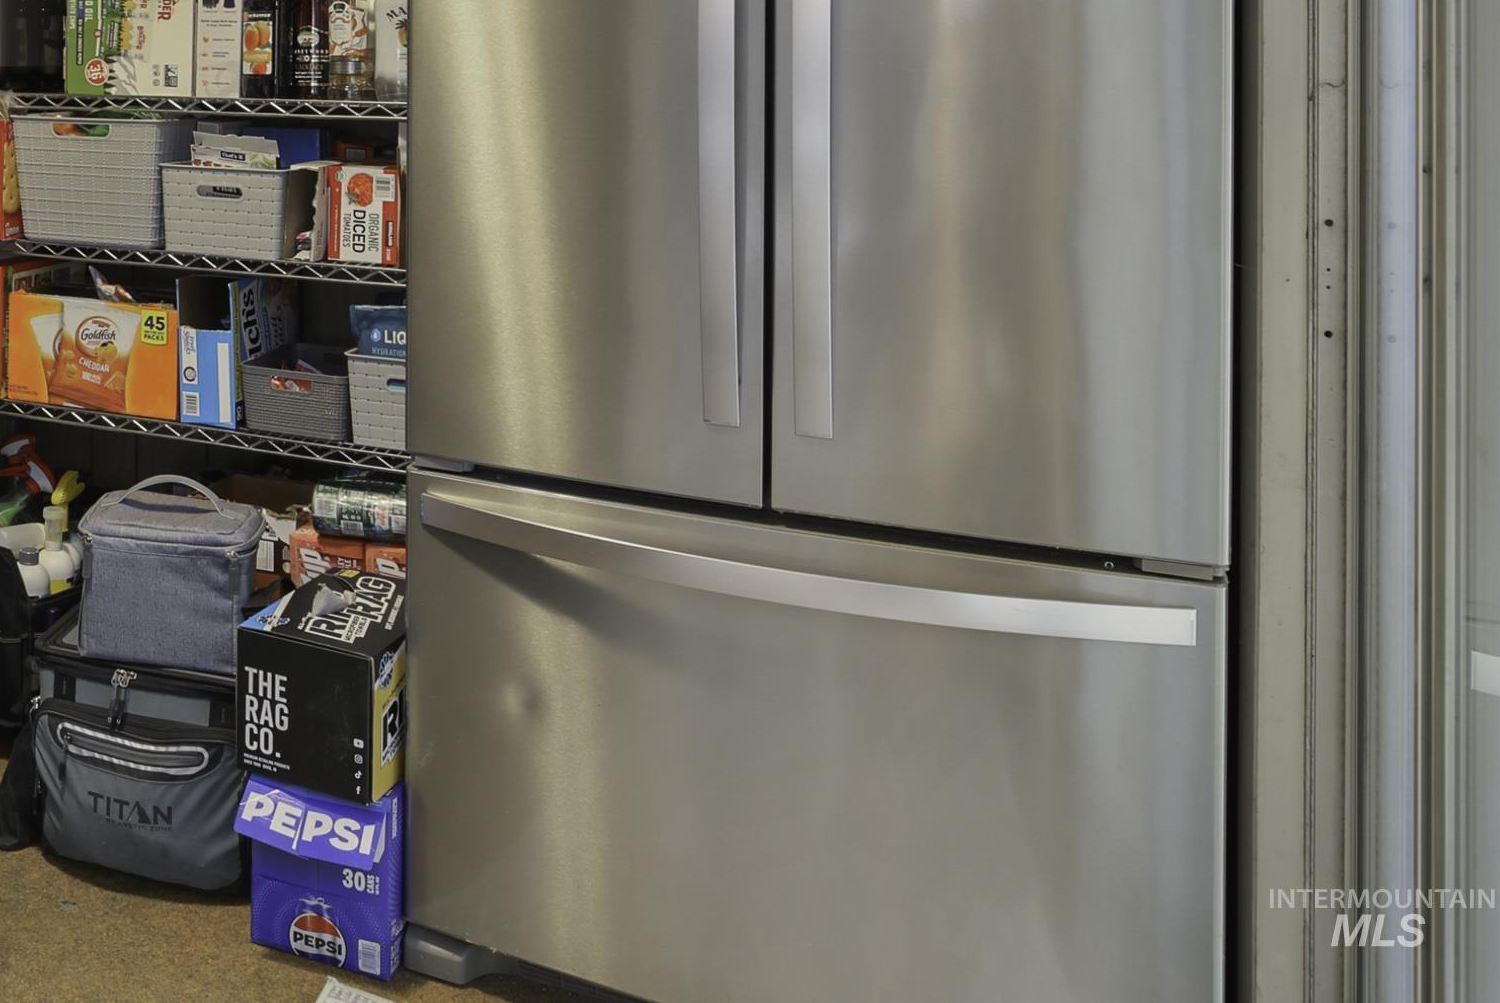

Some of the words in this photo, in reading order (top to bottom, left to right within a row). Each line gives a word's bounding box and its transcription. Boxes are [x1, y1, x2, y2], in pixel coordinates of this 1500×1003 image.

[84, 7, 93, 22] OIL
[343, 213, 351, 248] TOMATOES
[352, 209, 366, 253] DICED
[368, 213, 380, 252] ORGANIC
[81, 328, 116, 341] Goldfish
[144, 315, 165, 331] 45
[384, 331, 407, 345] LIQ
[78, 357, 110, 373] CHEDDAR
[351, 575, 396, 624] RAG
[244, 666, 288, 703] THE
[245, 694, 289, 731] RAG
[245, 723, 281, 758] CO.
[87, 790, 172, 826] TITAN
[241, 791, 375, 855] PEPSI
[342, 868, 366, 892] 30
[366, 875, 375, 894] CANS
[293, 931, 343, 957] PEPSI
